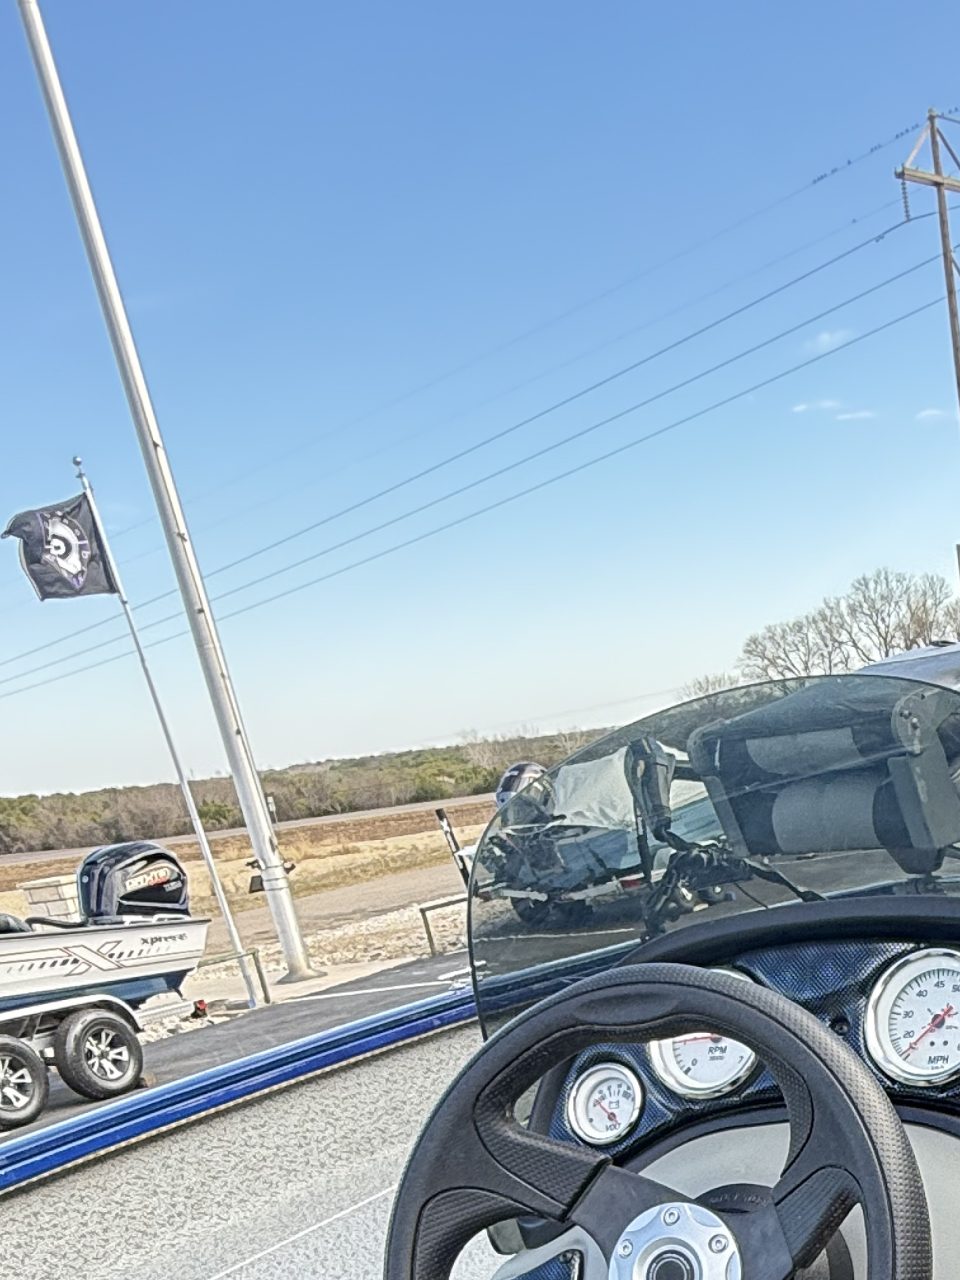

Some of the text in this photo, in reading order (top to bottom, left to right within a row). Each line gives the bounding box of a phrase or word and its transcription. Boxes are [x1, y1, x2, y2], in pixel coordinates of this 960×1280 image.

[934, 980, 945, 988] 45
[916, 989, 928, 998] 40
[902, 1010, 914, 1018] 30
[902, 1030, 915, 1038] 20
[707, 1045, 728, 1055] RPM
[691, 1058, 698, 1066] 0
[927, 1055, 949, 1064] MPH
